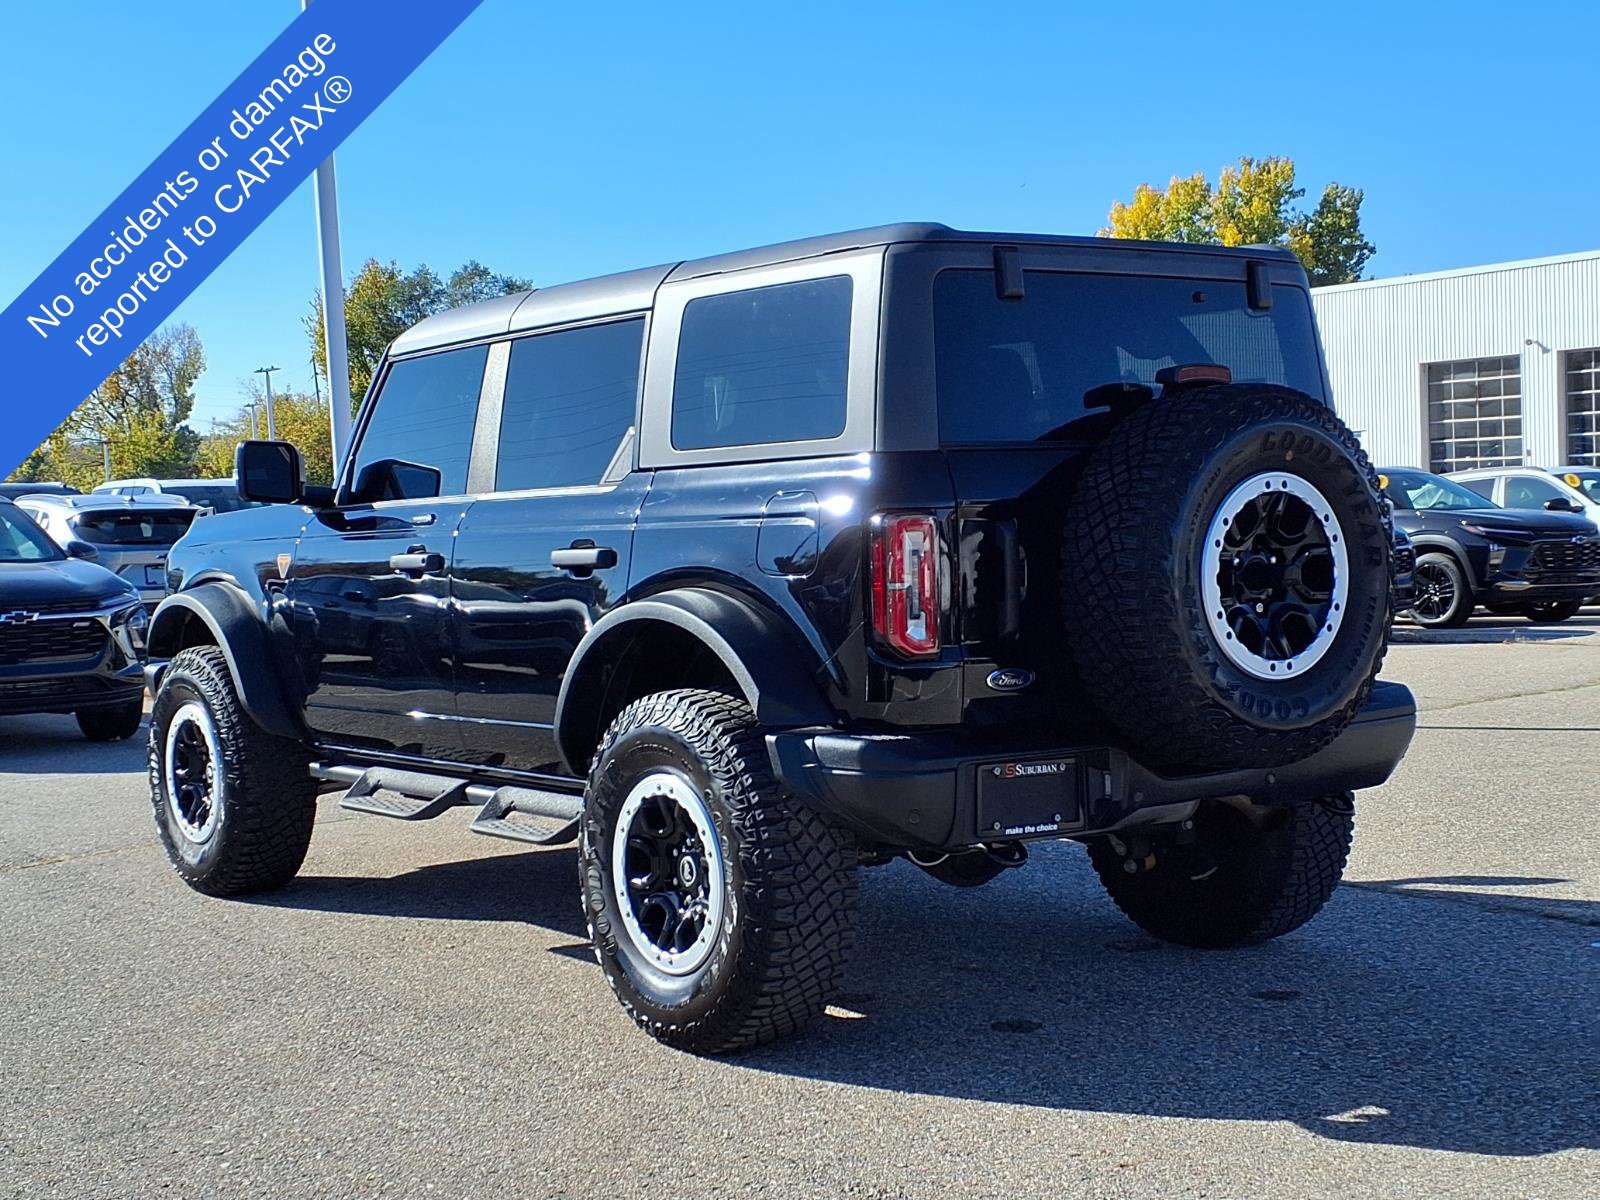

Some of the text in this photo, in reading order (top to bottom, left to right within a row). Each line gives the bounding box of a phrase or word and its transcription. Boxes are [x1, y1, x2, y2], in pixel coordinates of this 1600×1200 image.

[1016, 764, 1057, 775] SUBURBAN
[1005, 827, 1023, 835] make
[1037, 823, 1058, 832] choice
